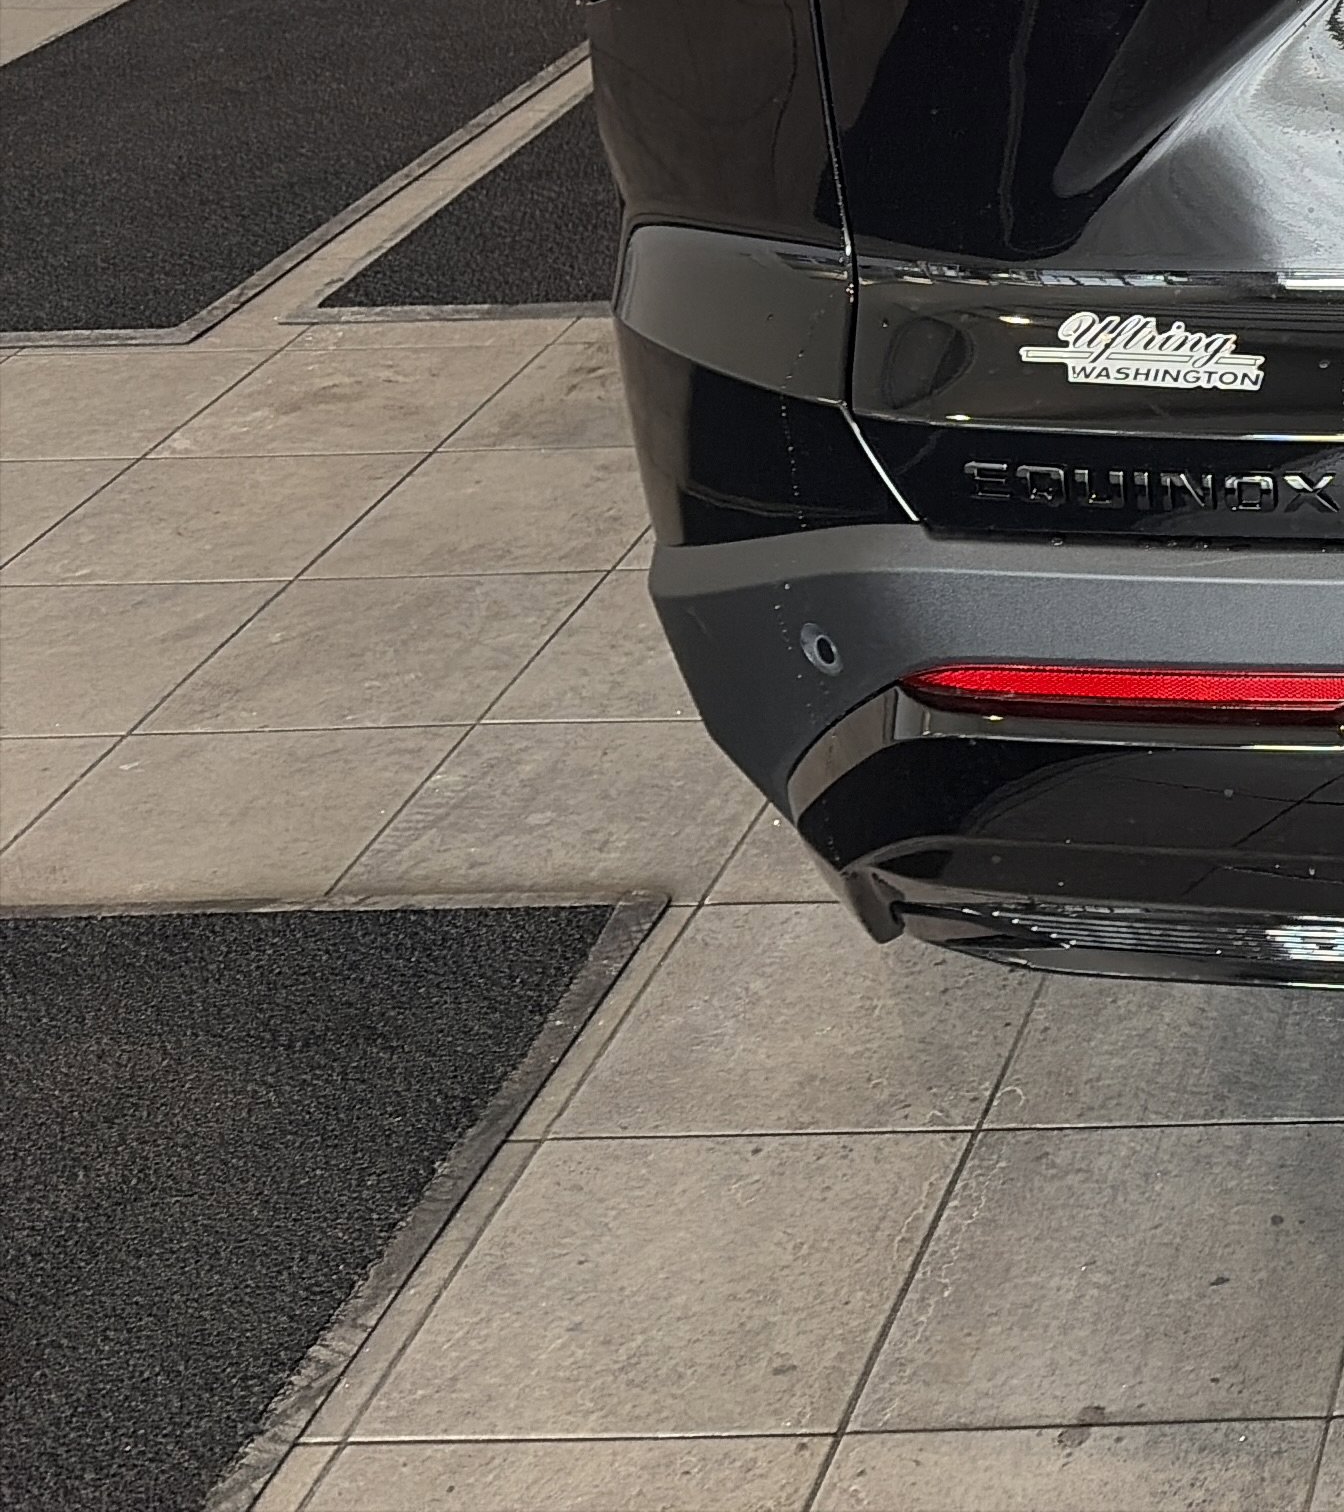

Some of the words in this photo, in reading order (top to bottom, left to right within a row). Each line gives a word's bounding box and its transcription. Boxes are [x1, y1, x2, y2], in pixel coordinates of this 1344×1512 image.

[1059, 312, 1239, 367] Uftring
[1070, 364, 1262, 388] WASHINGTON
[963, 460, 1341, 513] EQUINOX
